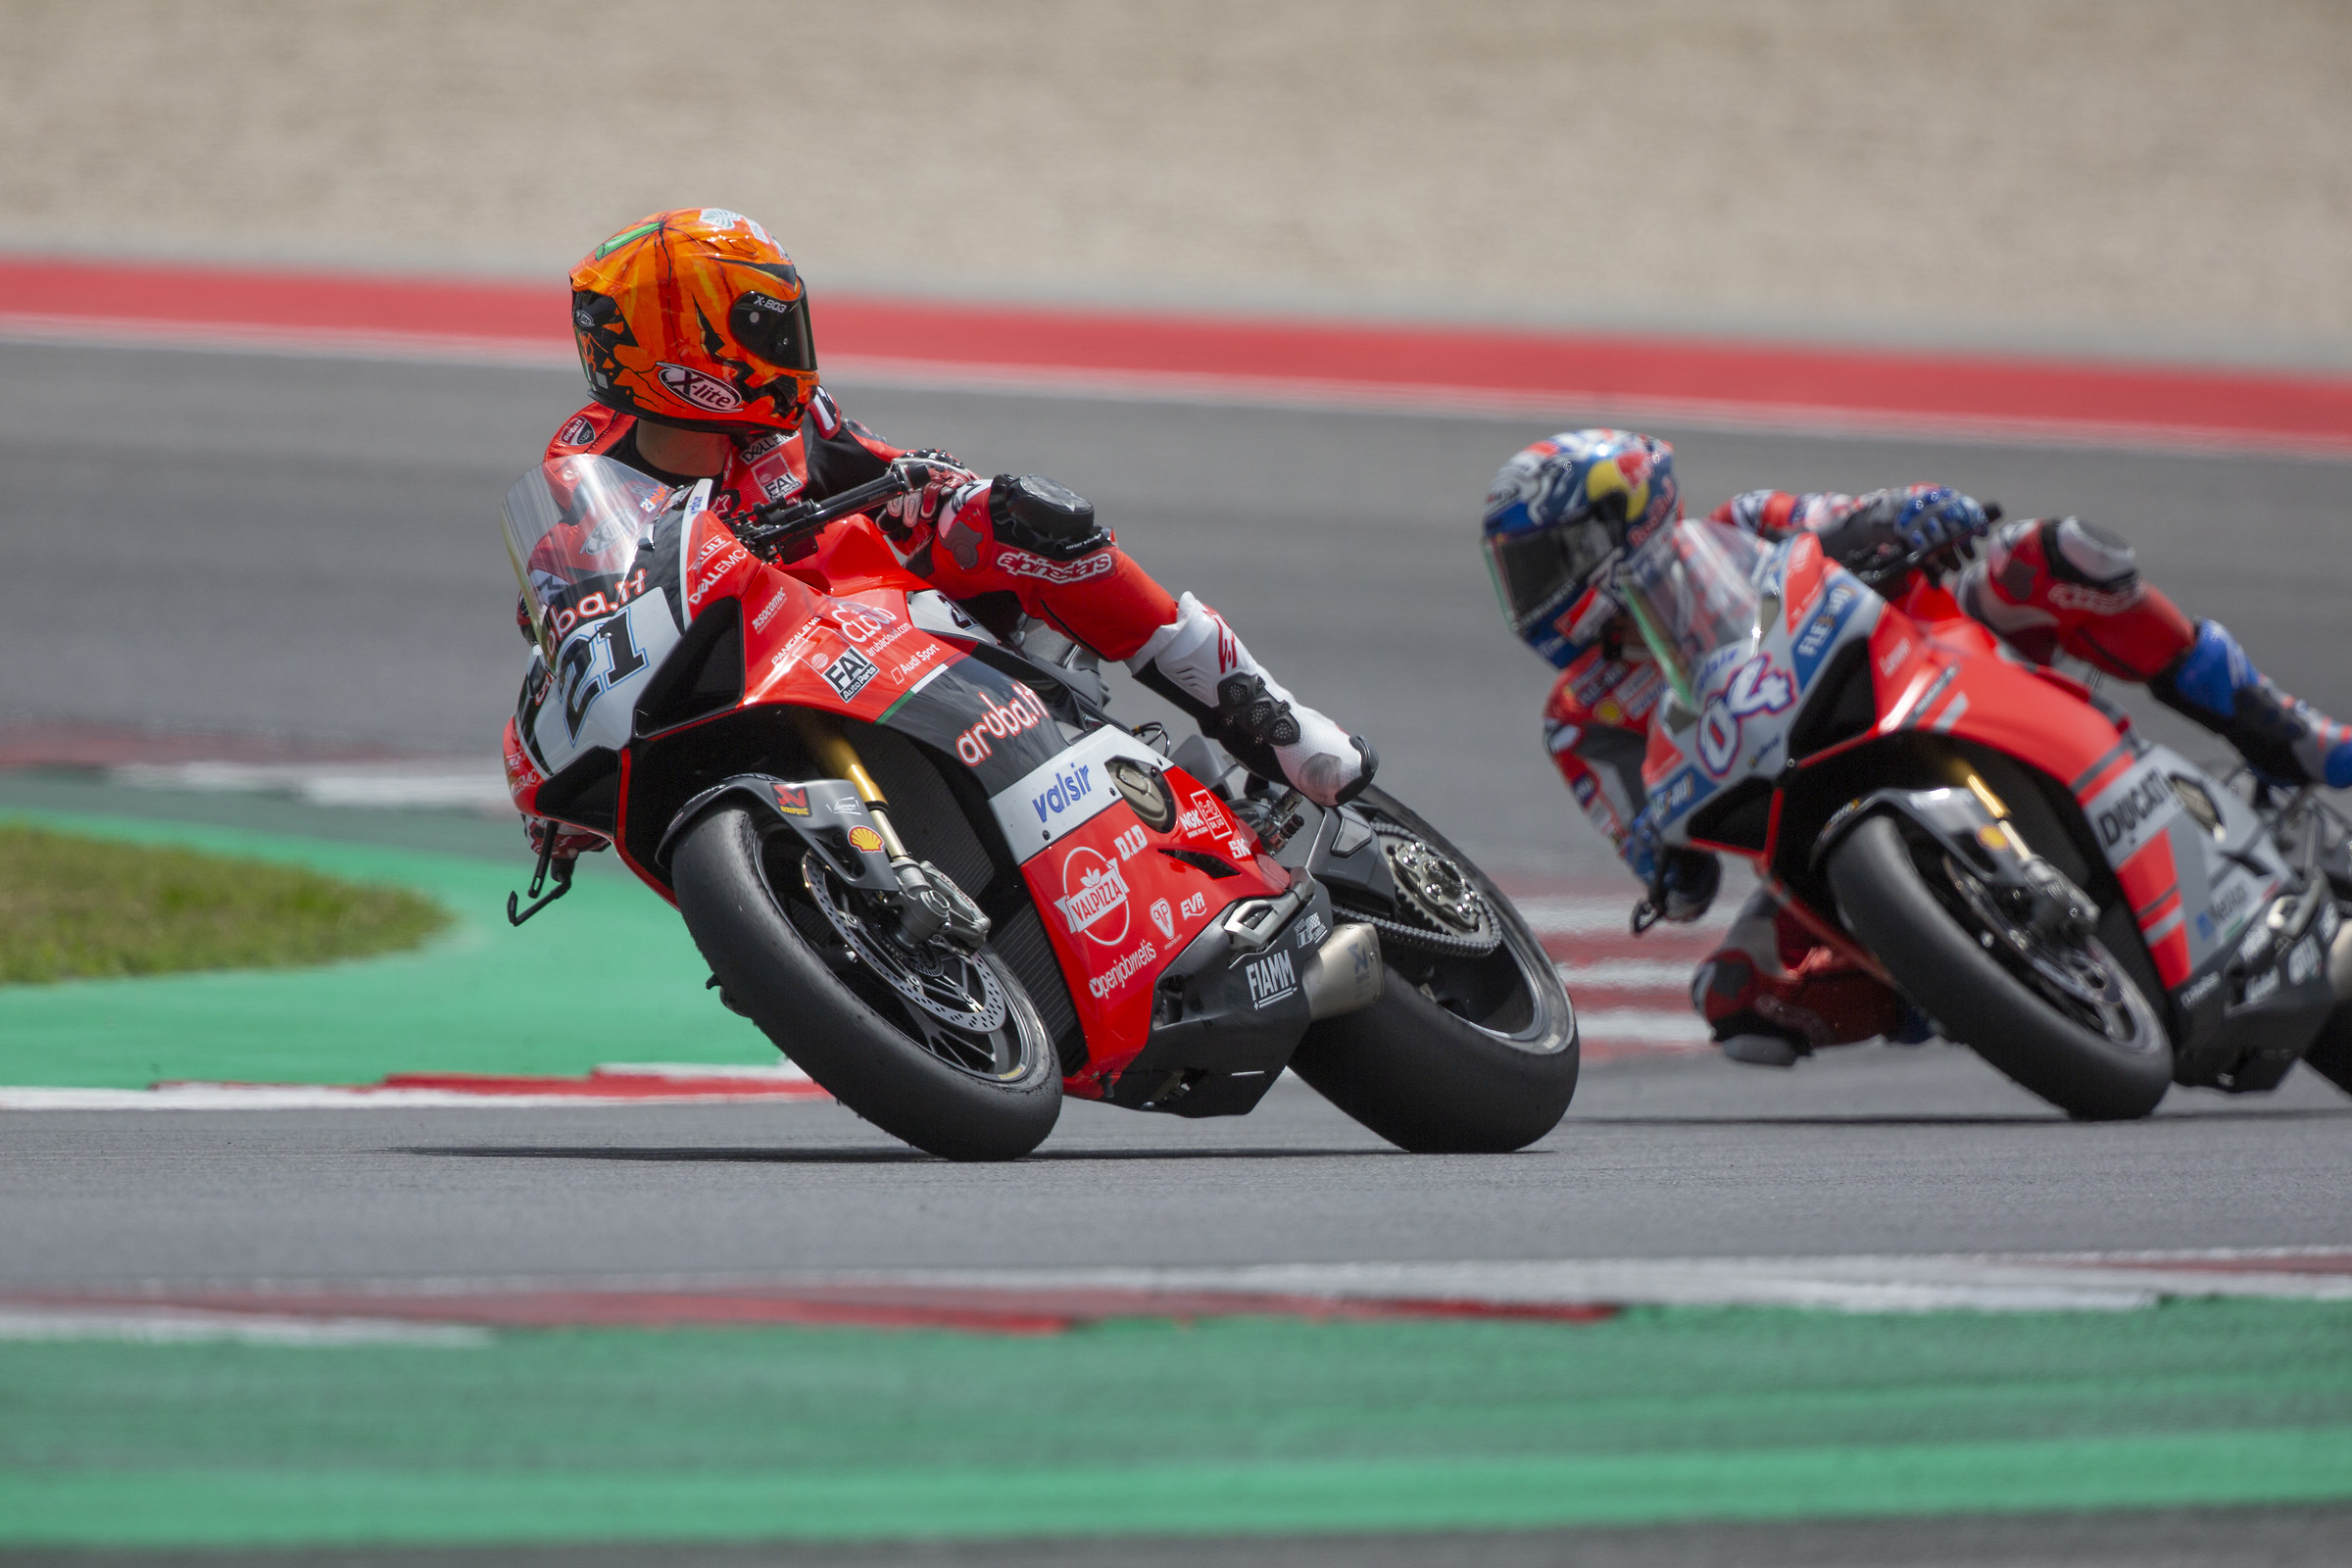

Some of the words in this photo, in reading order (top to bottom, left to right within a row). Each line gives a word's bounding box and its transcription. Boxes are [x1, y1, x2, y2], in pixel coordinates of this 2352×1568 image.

[754, 296, 787, 313] X-803
[665, 370, 732, 408] X-lite
[564, 418, 583, 442] DUCATI
[764, 472, 795, 496] FAI
[997, 552, 1112, 584] alpinestars
[758, 586, 786, 624] socomec
[771, 623, 811, 665] PANIGALE
[841, 608, 897, 643] CLOUD
[865, 622, 912, 658] arubacloud.com
[555, 605, 649, 748] 21
[824, 647, 868, 690] FAI
[900, 656, 922, 675] Audi
[915, 643, 940, 662] Sport
[843, 680, 861, 699] Auto
[859, 665, 877, 684] Parts
[956, 679, 1049, 766] aruba.it
[1696, 650, 1799, 781] 04
[1032, 762, 1092, 823] valsir
[1179, 808, 1204, 831] NGK
[1071, 878, 1123, 922] VALPIZZA
[1089, 939, 1156, 999] Openjobmetis
[1246, 949, 1296, 1002] FIAMM
